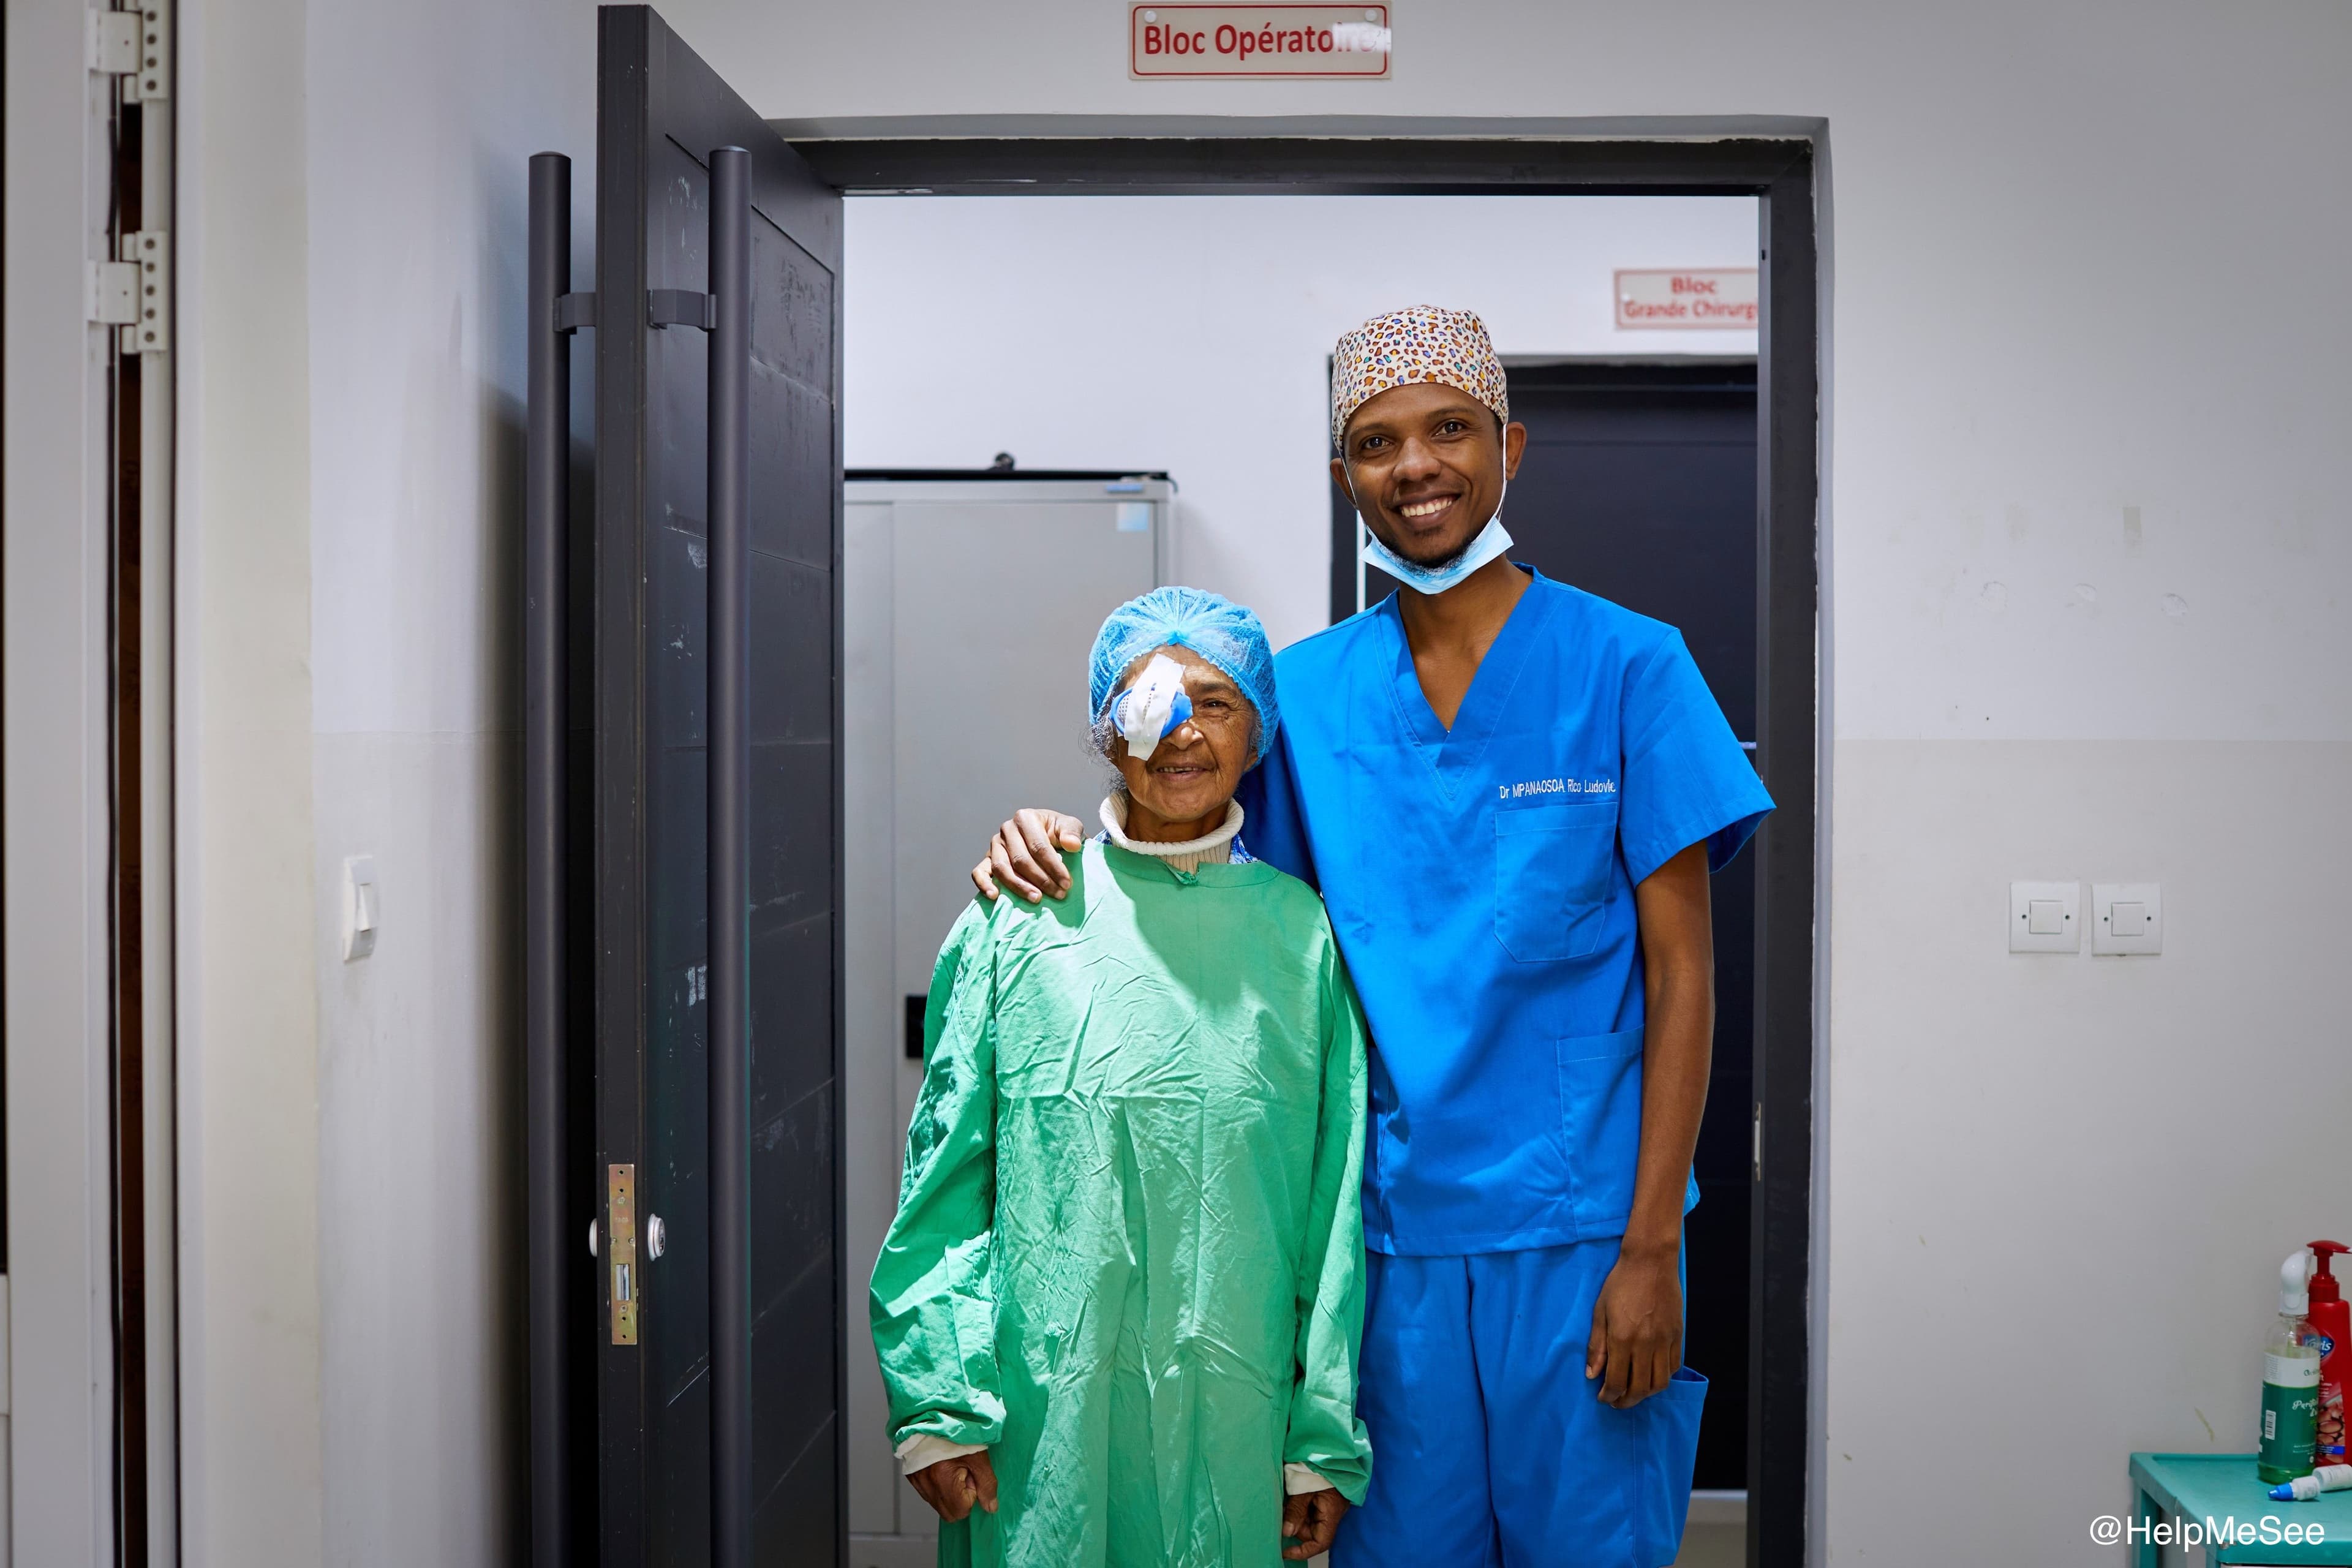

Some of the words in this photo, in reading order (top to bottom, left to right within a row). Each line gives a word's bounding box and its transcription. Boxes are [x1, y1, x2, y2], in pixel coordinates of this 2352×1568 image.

[1145, 24, 1205, 55] Bloc
[1215, 22, 1373, 61] Opérato
[1670, 276, 1716, 294] Bloc
[1624, 299, 1686, 318] Grande
[1499, 785, 1510, 799] Dr
[1512, 778, 1566, 798] MPANAOSOA
[1567, 779, 1581, 793] Rico
